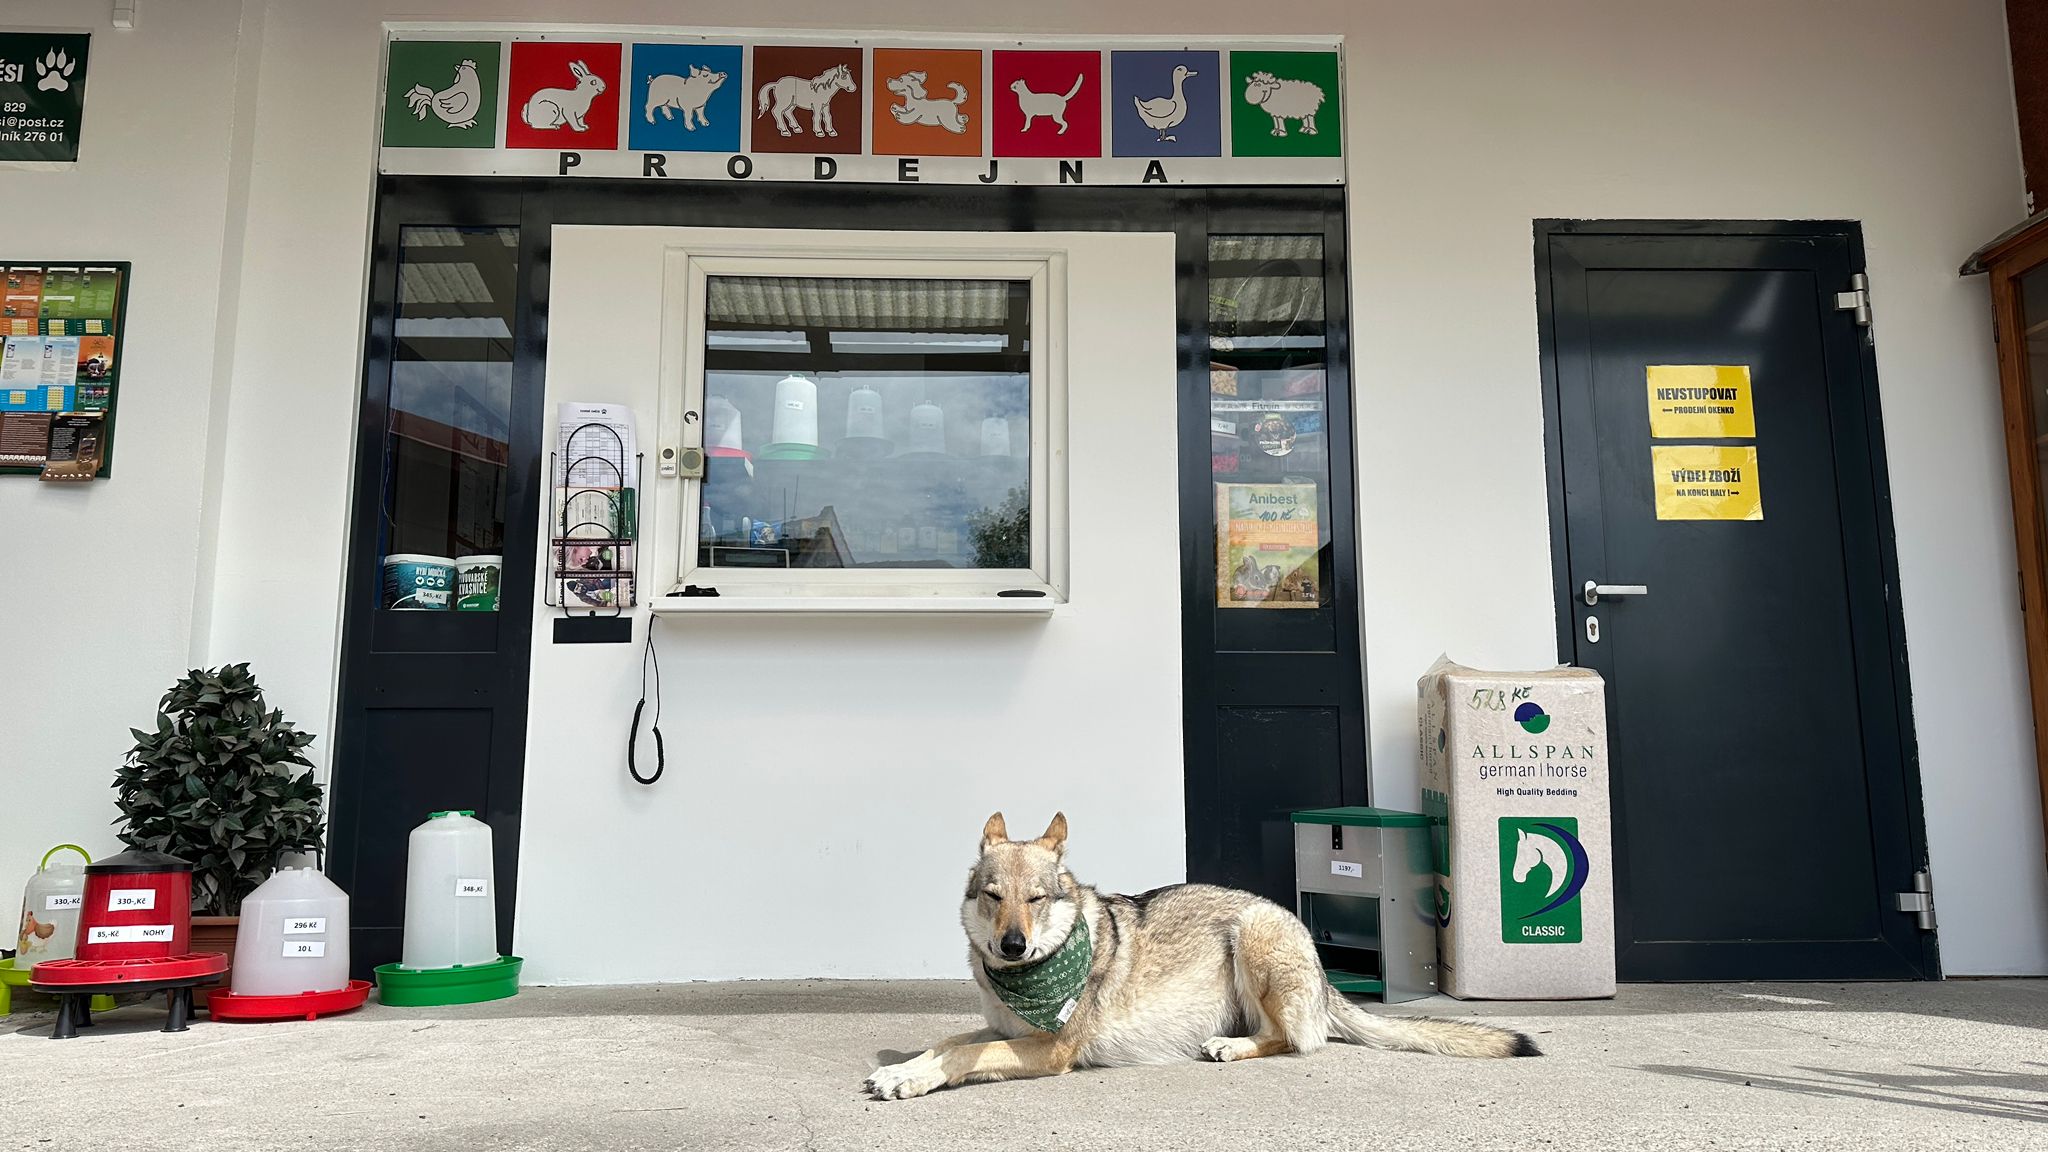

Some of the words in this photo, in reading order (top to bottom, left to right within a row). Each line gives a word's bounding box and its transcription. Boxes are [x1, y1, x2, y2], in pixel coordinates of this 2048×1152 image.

[4, 102, 27, 112] 829
[0, 116, 64, 129] i@post.cz
[24, 131, 47, 142] 276
[50, 132, 63, 142] 01
[559, 152, 1168, 184] PRODEJNA
[1657, 387, 1738, 401] NEVSTUPOVAT
[1674, 404, 1707, 414] PRODEJNÍ
[1708, 406, 1735, 415] OKENKO
[1671, 467, 1707, 483] VÝDEJ
[1709, 467, 1741, 483] ZBOŽÍ
[1676, 488, 1687, 497] NA
[1687, 488, 1709, 497] KONCI
[1710, 488, 1726, 497] HALY
[1249, 493, 1298, 505] Anibest
[1259, 510, 1278, 521] 100
[1472, 745, 1594, 759] ALLSPAN
[1479, 763, 1536, 780] german
[1546, 763, 1587, 777] horse
[1496, 787, 1515, 797] High
[1516, 787, 1544, 798] Quality
[1546, 787, 1578, 798] Bedding
[97, 930, 120, 939] 85,-Kč
[1521, 925, 1565, 937] CLASSIC
